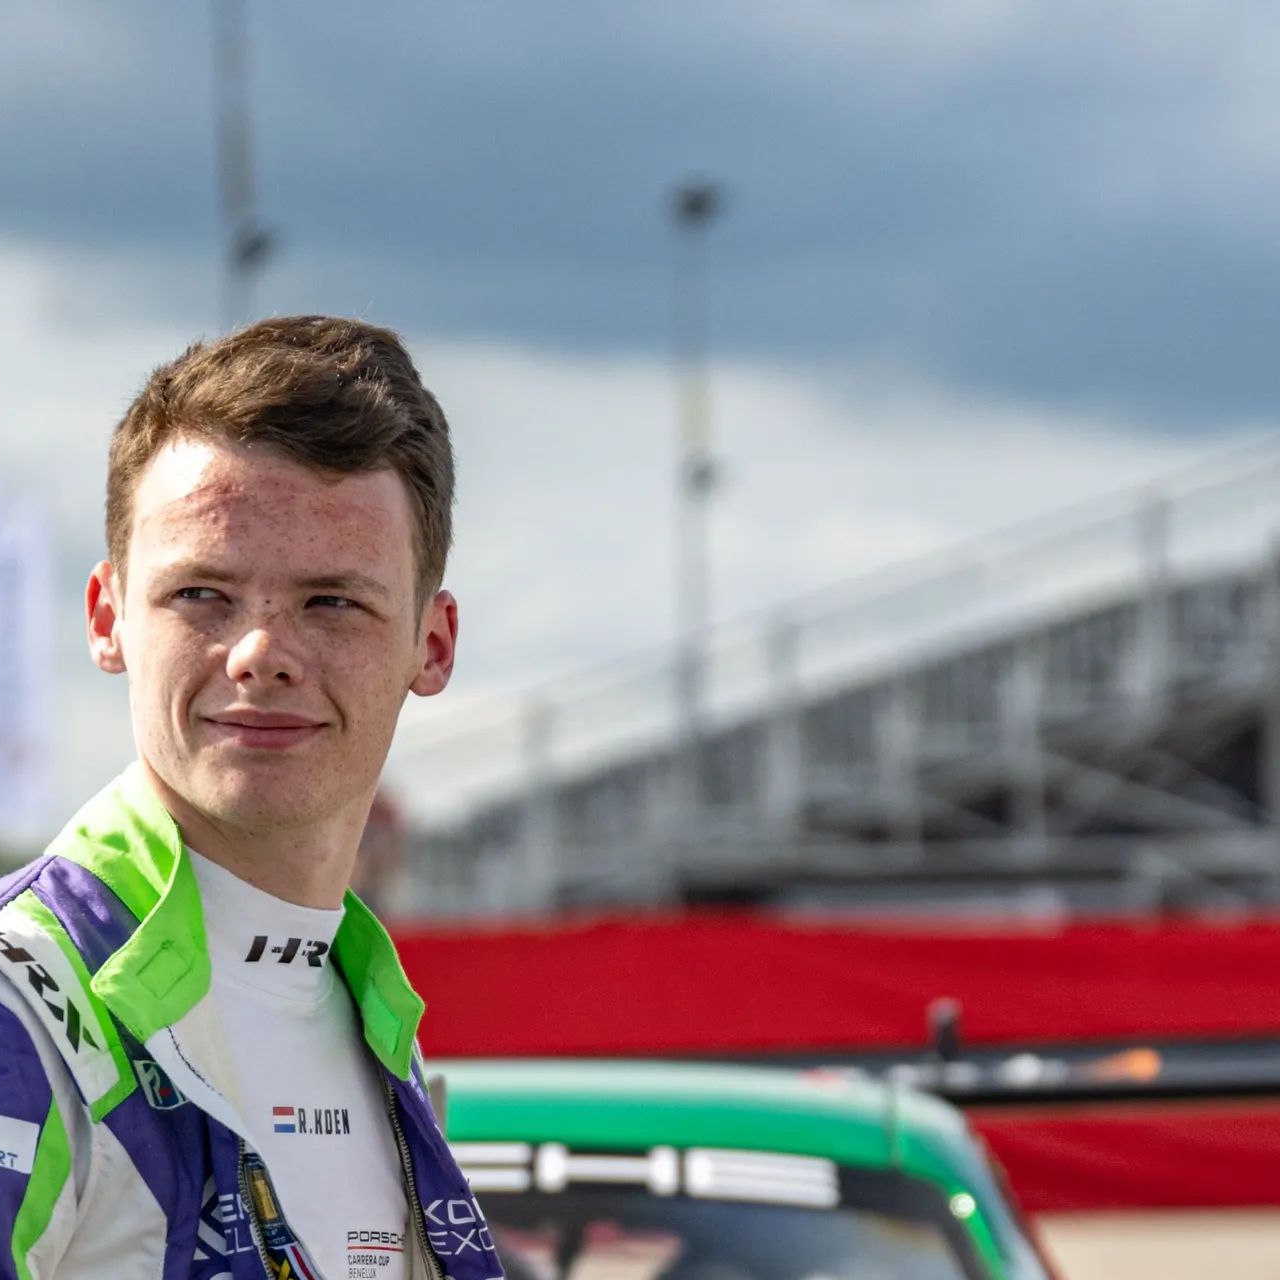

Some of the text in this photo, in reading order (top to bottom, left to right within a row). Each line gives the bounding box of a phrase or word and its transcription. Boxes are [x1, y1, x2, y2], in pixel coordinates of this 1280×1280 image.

[297, 1107, 351, 1135] R.KOEN
[347, 1254, 390, 1267] CARRERA CUP
[348, 1267, 377, 1279] BENELUX
